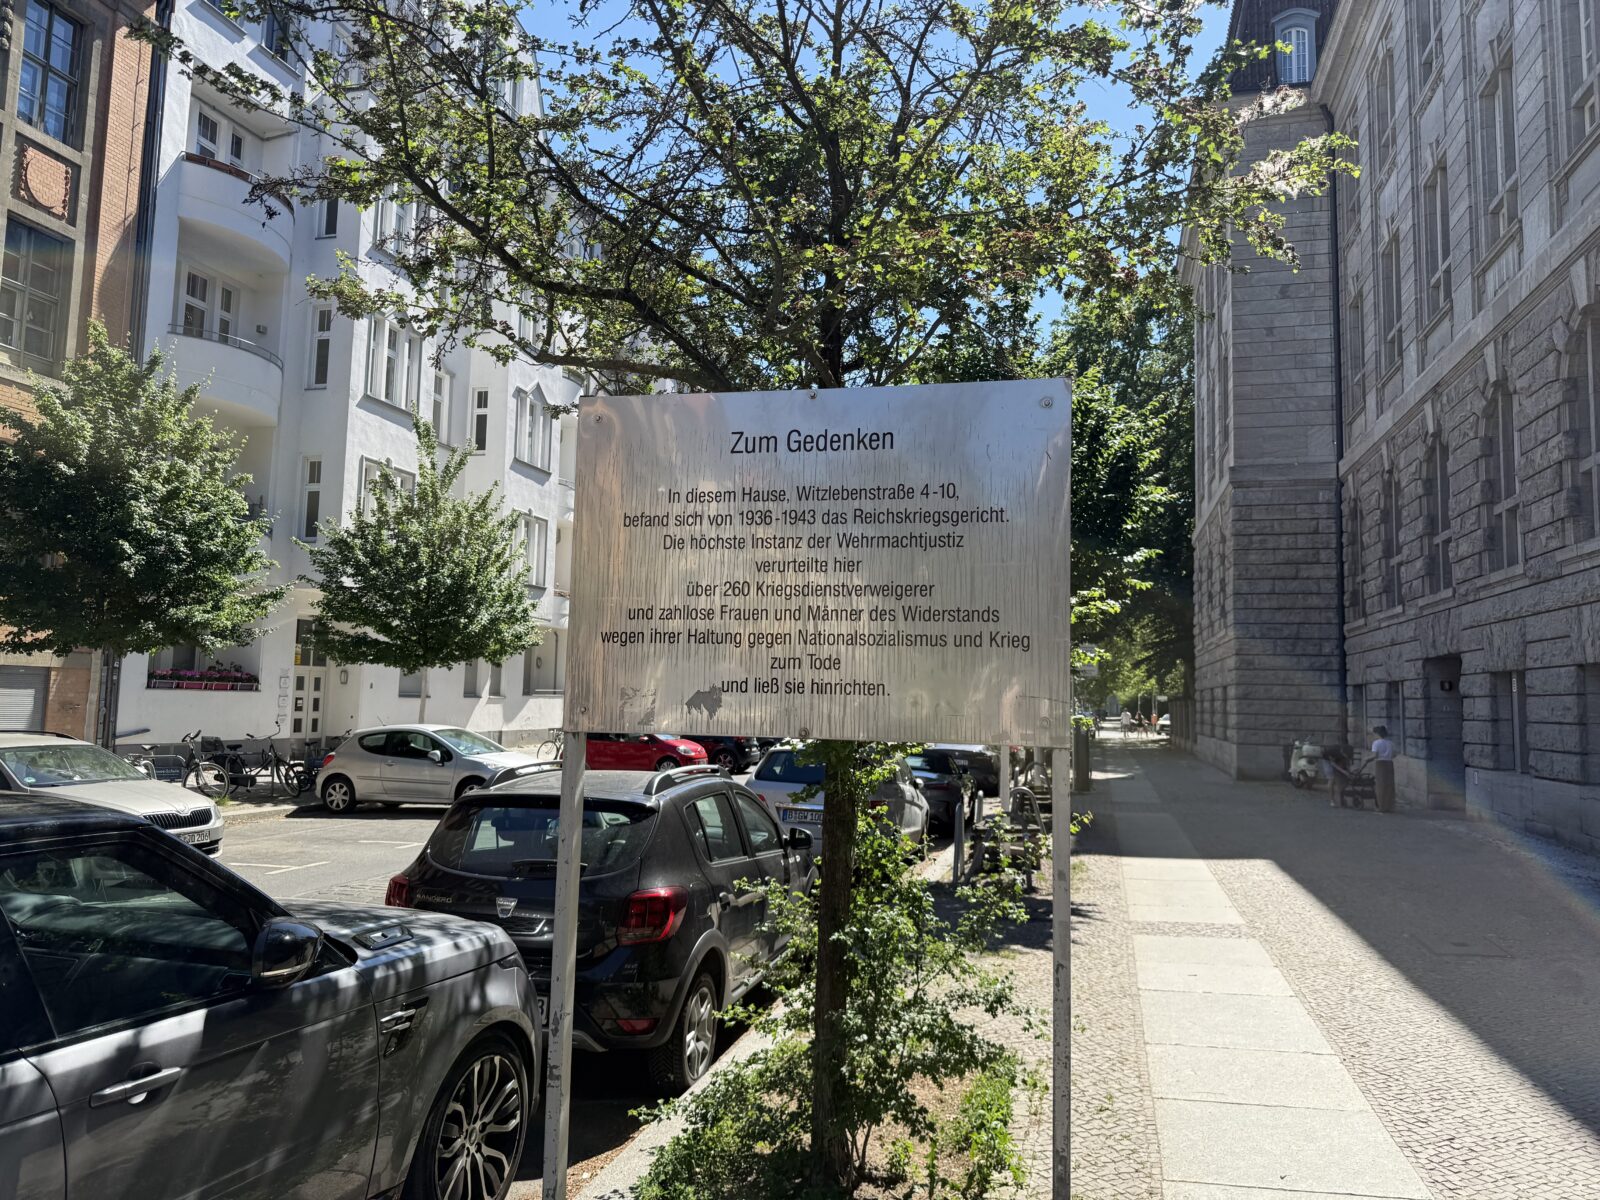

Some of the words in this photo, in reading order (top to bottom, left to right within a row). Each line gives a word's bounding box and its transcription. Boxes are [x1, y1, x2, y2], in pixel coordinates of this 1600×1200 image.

[730, 431, 778, 454] Zum
[786, 428, 894, 453] Gedenken
[668, 488, 680, 504] In
[686, 487, 737, 504] diesem
[742, 486, 790, 504] Hause,
[796, 484, 915, 502] Witzlebenstraße
[623, 512, 670, 528] befand
[674, 511, 703, 527] sich
[708, 513, 733, 526] von
[821, 509, 848, 525] das
[853, 507, 1010, 527] Reichskriegsgericht.
[663, 534, 685, 550] Die
[690, 533, 746, 550] höchste
[751, 533, 803, 549] Instanz
[807, 533, 832, 549] der
[836, 531, 964, 552] Wehrmachtjustiz
[755, 556, 828, 573] verurteilte
[833, 557, 863, 573] hier
[687, 581, 718, 597] über
[723, 581, 750, 597] 260
[755, 580, 935, 601] Kriegsdienstverweigerer
[628, 604, 653, 621] und
[658, 604, 715, 621] zahllose
[720, 605, 769, 621] Frauen
[774, 605, 801, 621] und
[807, 605, 865, 622] Männer
[869, 605, 896, 622] des
[902, 605, 1000, 623] Widerstands
[600, 631, 645, 647] wegen
[650, 628, 682, 644] ihrer
[687, 628, 742, 648] Haltung
[747, 631, 792, 649] gegen
[798, 629, 948, 647] Nationalsozialismus
[953, 631, 982, 648] und
[989, 631, 1031, 652] Krieg
[770, 657, 801, 670] zum
[806, 653, 841, 670] Tode
[721, 677, 748, 693] und
[754, 677, 779, 694] ließ
[784, 678, 805, 694] sie
[810, 678, 891, 697] hinrichten.
